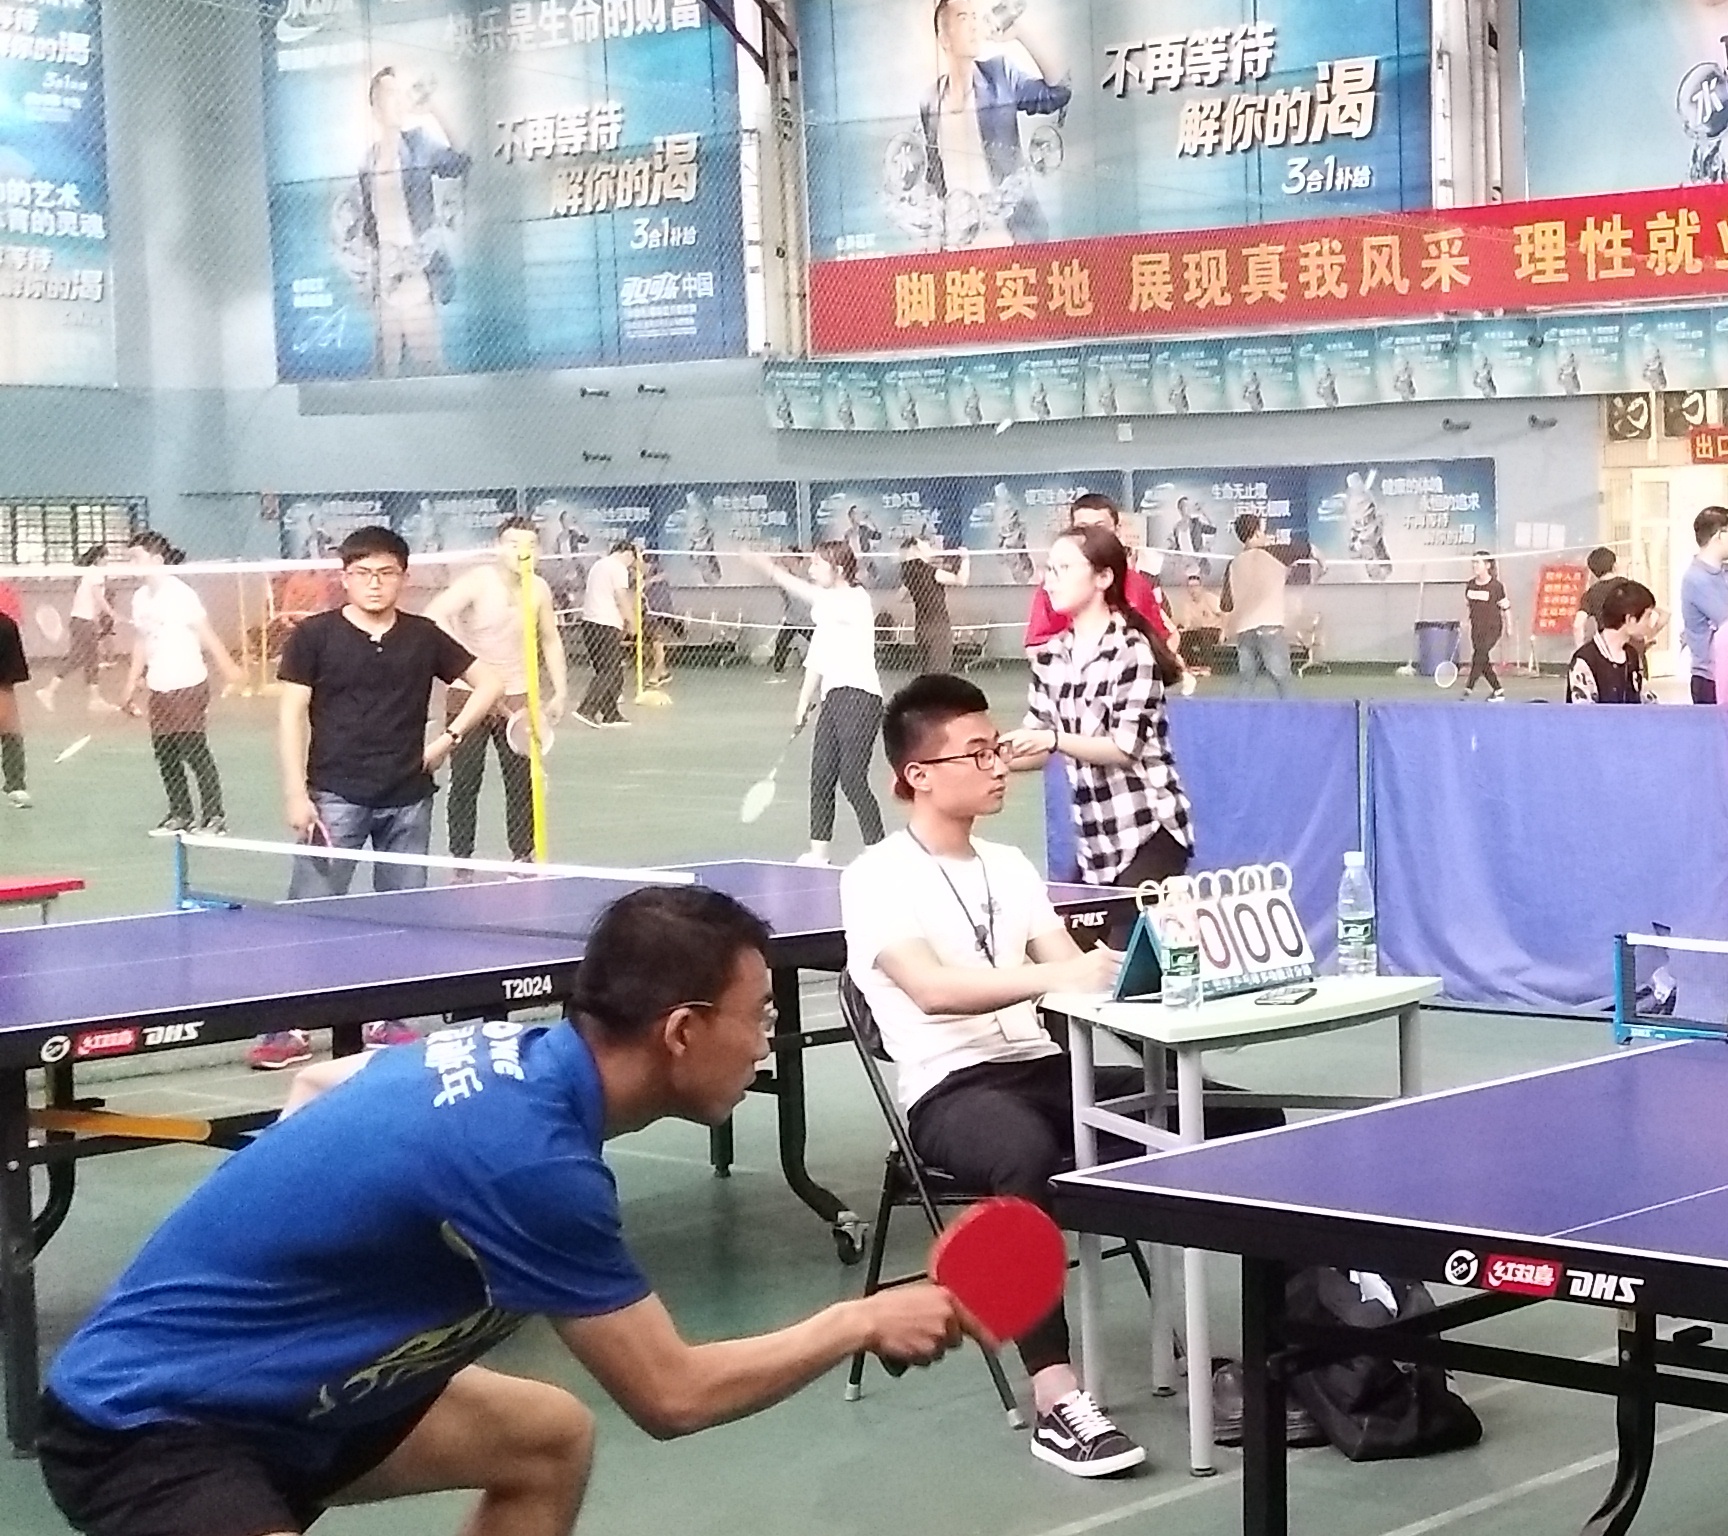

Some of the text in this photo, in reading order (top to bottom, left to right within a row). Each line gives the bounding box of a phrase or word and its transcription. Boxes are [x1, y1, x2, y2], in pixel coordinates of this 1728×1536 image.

[1099, 20, 1277, 101] 不再等待
[495, 100, 625, 165] 不再等待
[1175, 56, 1378, 160] 解你的渴
[549, 132, 701, 218] 解你的渴
[893, 259, 1094, 330] 脚踏实地
[1129, 227, 1472, 314] 展现真我风采
[502, 973, 554, 1001] T2024
[141, 1020, 205, 1046] DHS
[1488, 1260, 1645, 1304] 红双喜 DHS
